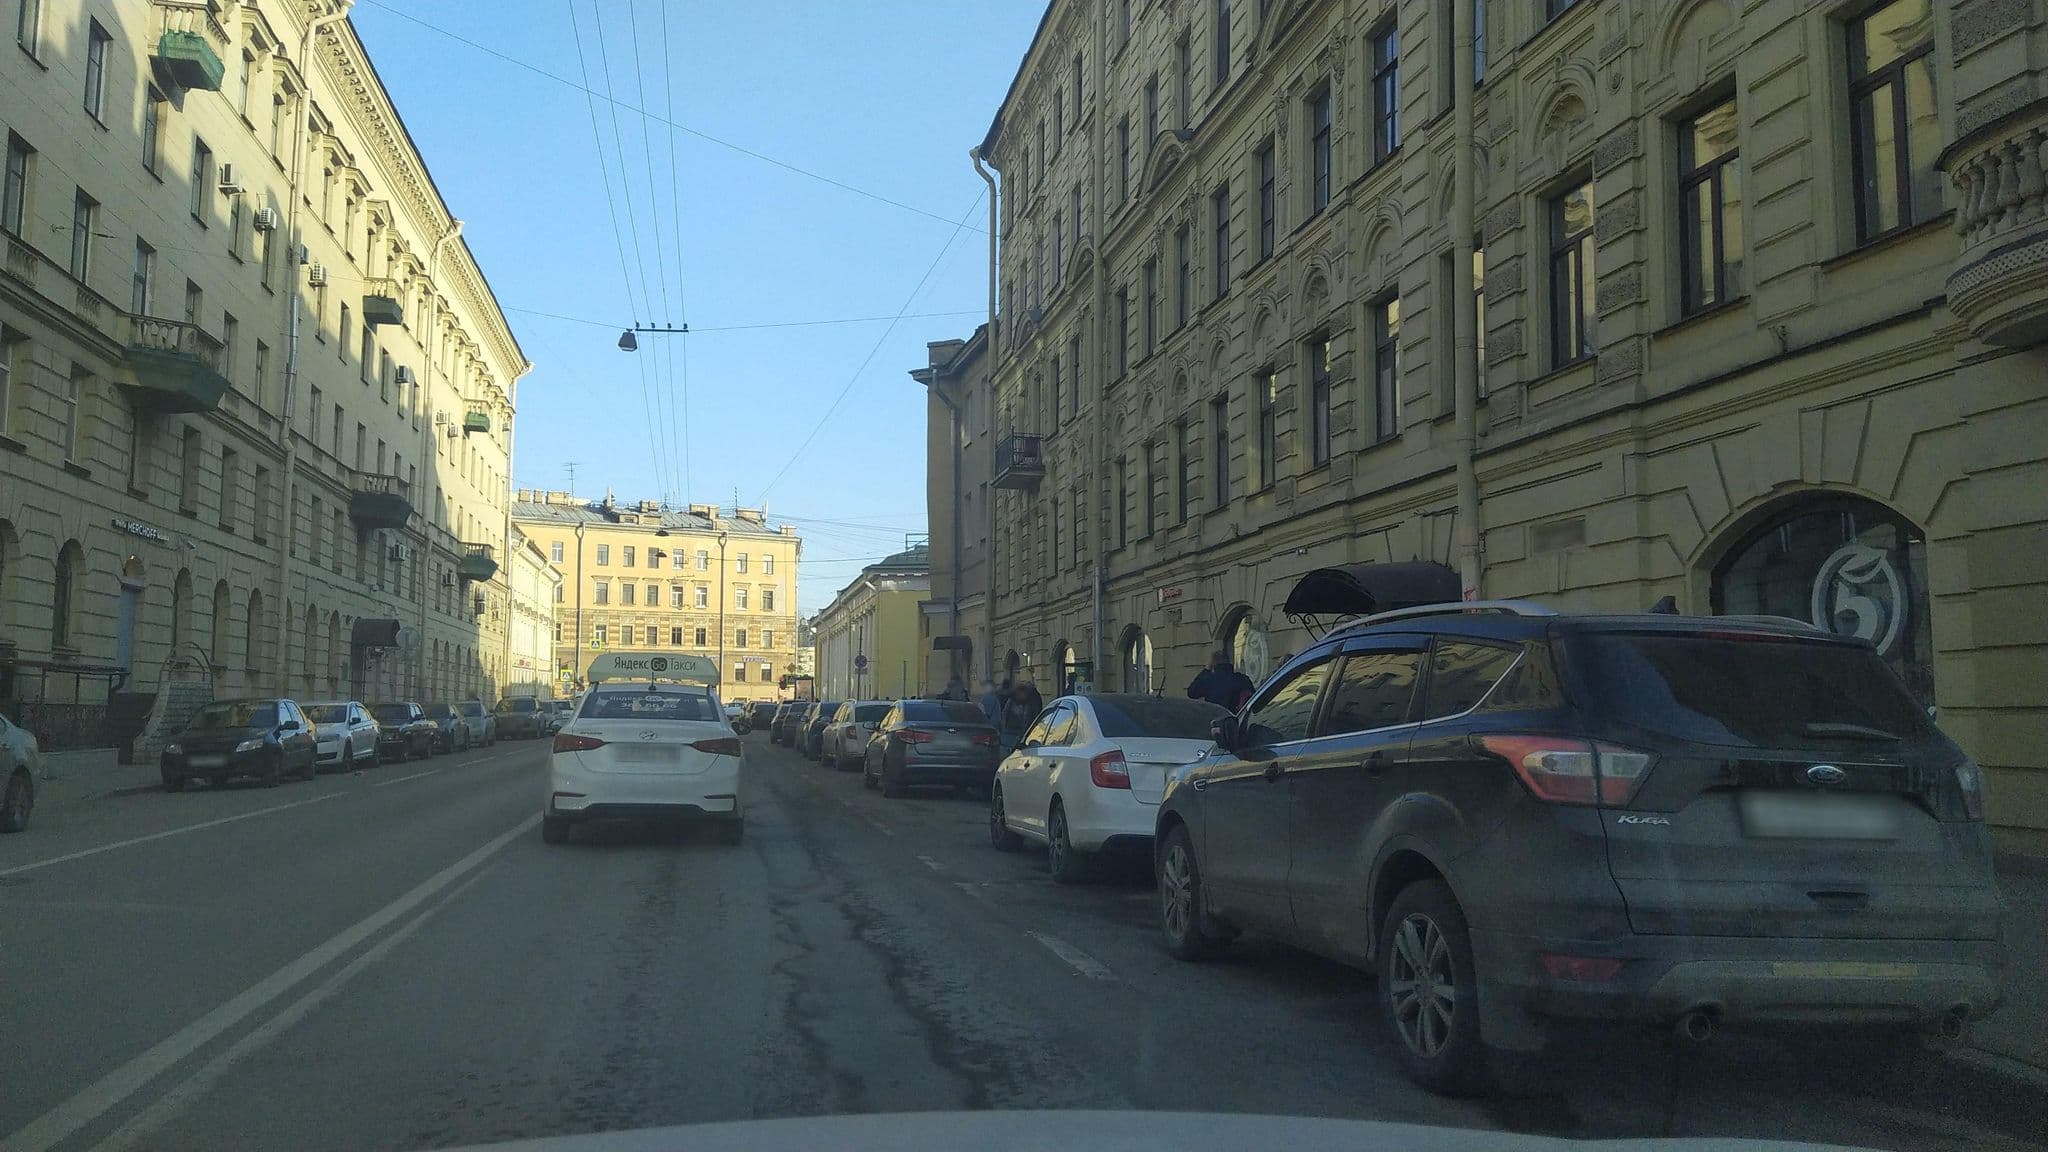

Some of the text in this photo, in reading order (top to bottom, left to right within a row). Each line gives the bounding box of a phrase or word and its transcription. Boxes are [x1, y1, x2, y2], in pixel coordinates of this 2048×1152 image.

[614, 656, 649, 670] Яндекс
[652, 659, 667, 671] Go
[670, 658, 696, 671] Такси
